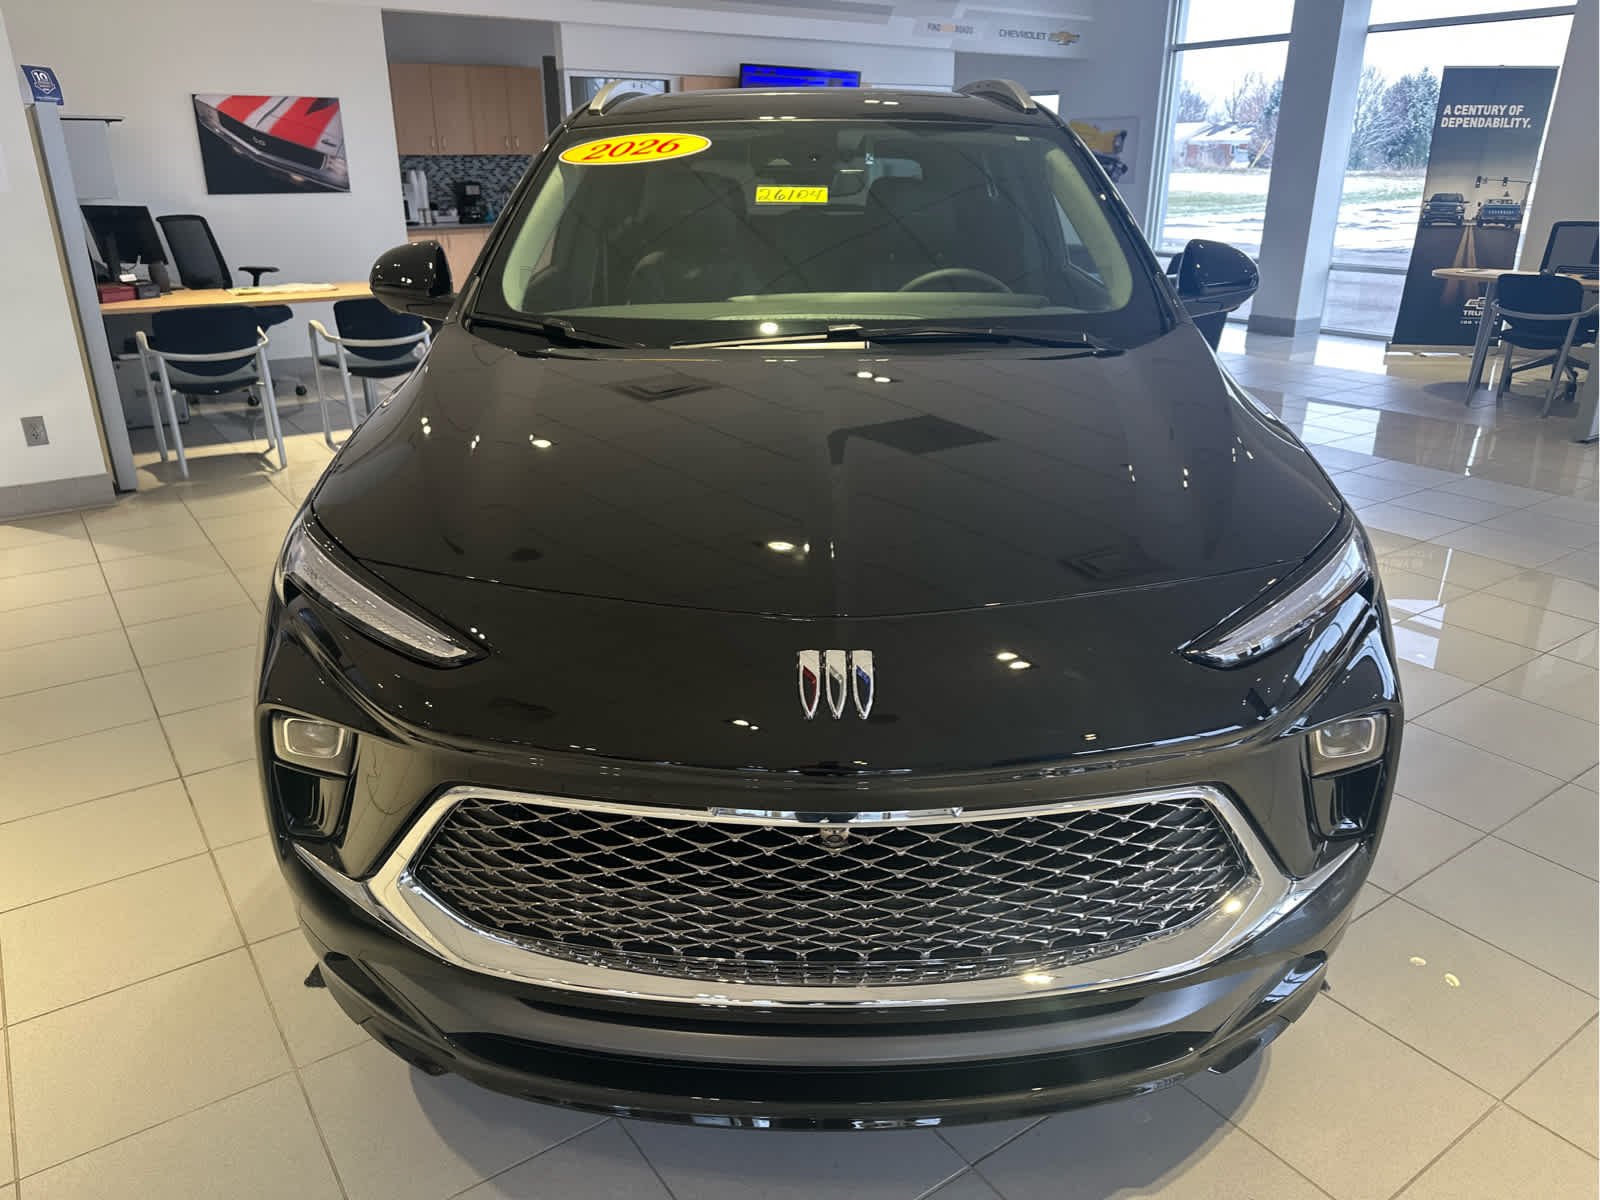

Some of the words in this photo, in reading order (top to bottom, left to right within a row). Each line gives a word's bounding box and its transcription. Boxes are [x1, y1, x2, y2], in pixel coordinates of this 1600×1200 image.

[999, 28, 1047, 40] CHEVROLET
[1443, 105, 1452, 115] A
[1454, 105, 1507, 115] CENTURY
[1508, 105, 1524, 115] OF
[1441, 117, 1531, 128] DEPENDABILITY.
[581, 137, 688, 161] 2026
